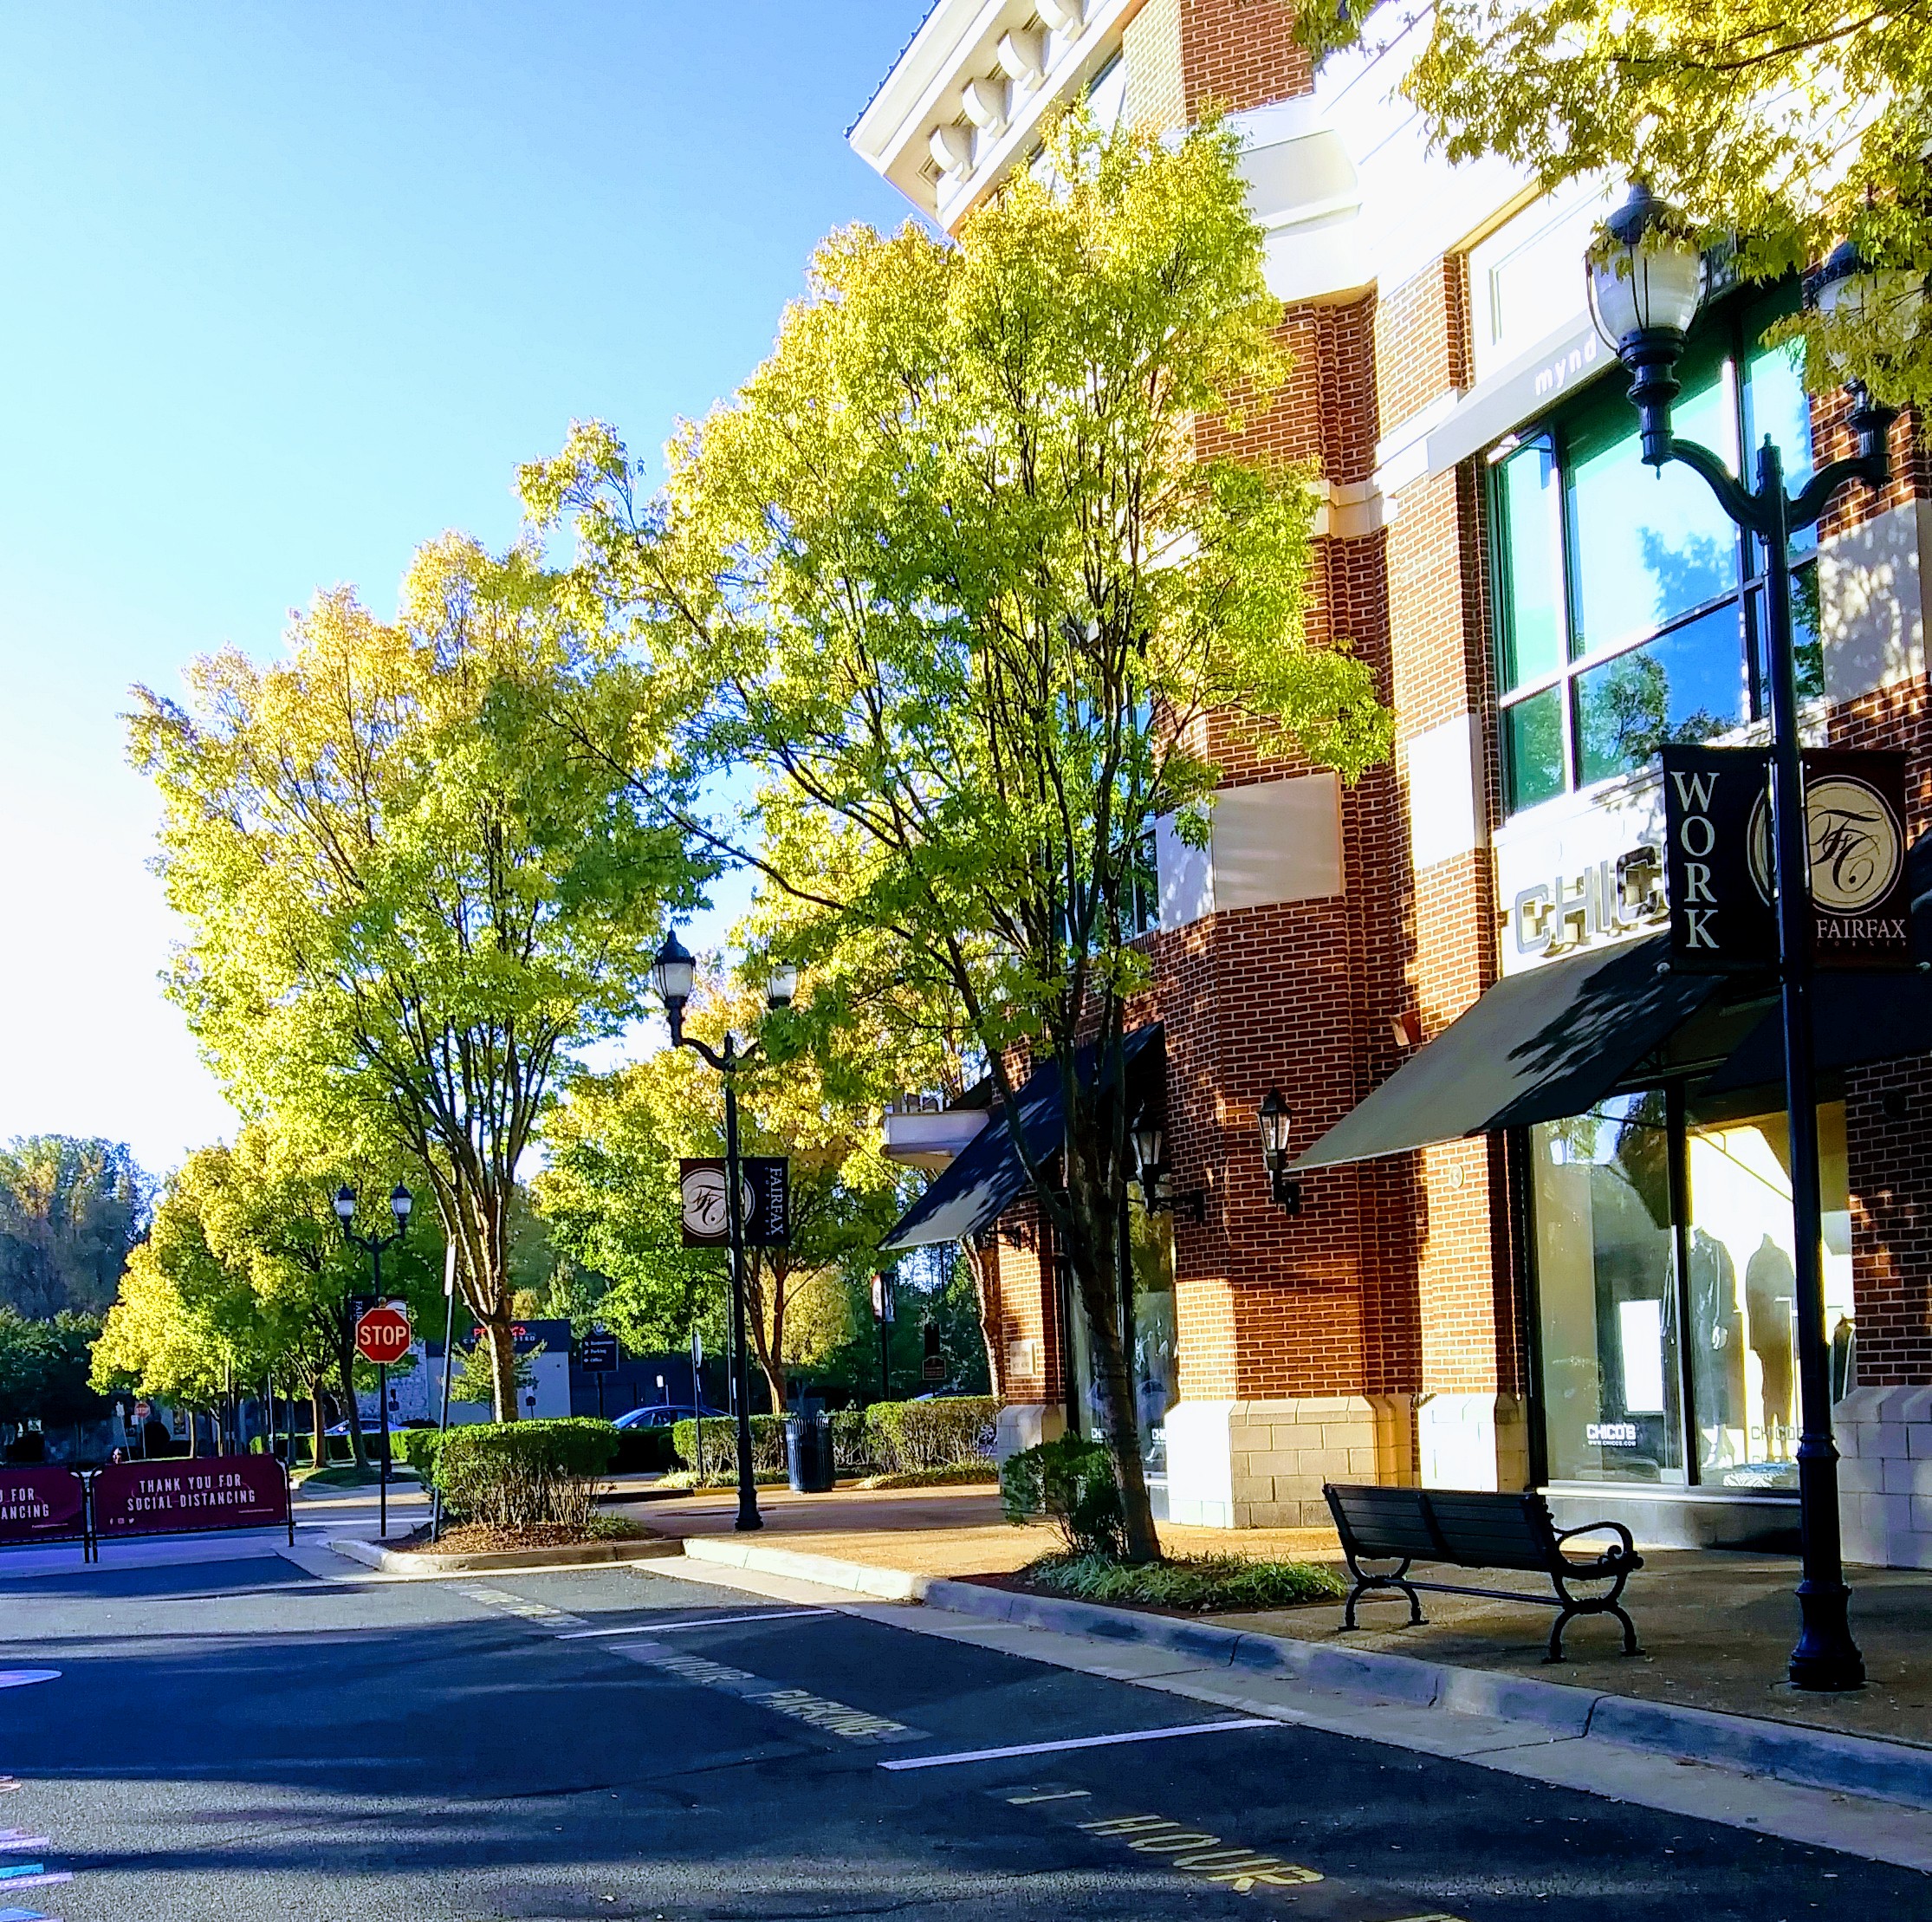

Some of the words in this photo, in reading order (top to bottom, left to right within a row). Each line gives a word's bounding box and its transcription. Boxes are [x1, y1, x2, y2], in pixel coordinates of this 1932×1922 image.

[1535, 331, 1597, 396] mynd
[1670, 771, 1720, 948] WORK
[1515, 841, 1670, 954] CHIC
[1816, 919, 1907, 938] FAIRFAX
[770, 1167, 784, 1236] FAIRFAX
[360, 1326, 406, 1346] STOP
[1585, 1422, 1637, 1440] CHICO'S
[139, 1477, 181, 1493] THANK
[187, 1475, 211, 1490] YOU
[219, 1473, 242, 1488] FOR
[11, 1487, 35, 1502] FOR
[126, 1495, 173, 1511] SOCIAL
[179, 1490, 256, 1508] DISTANCING
[1, 1503, 49, 1520] ANCING
[1076, 1814, 1326, 1892] HOUR
